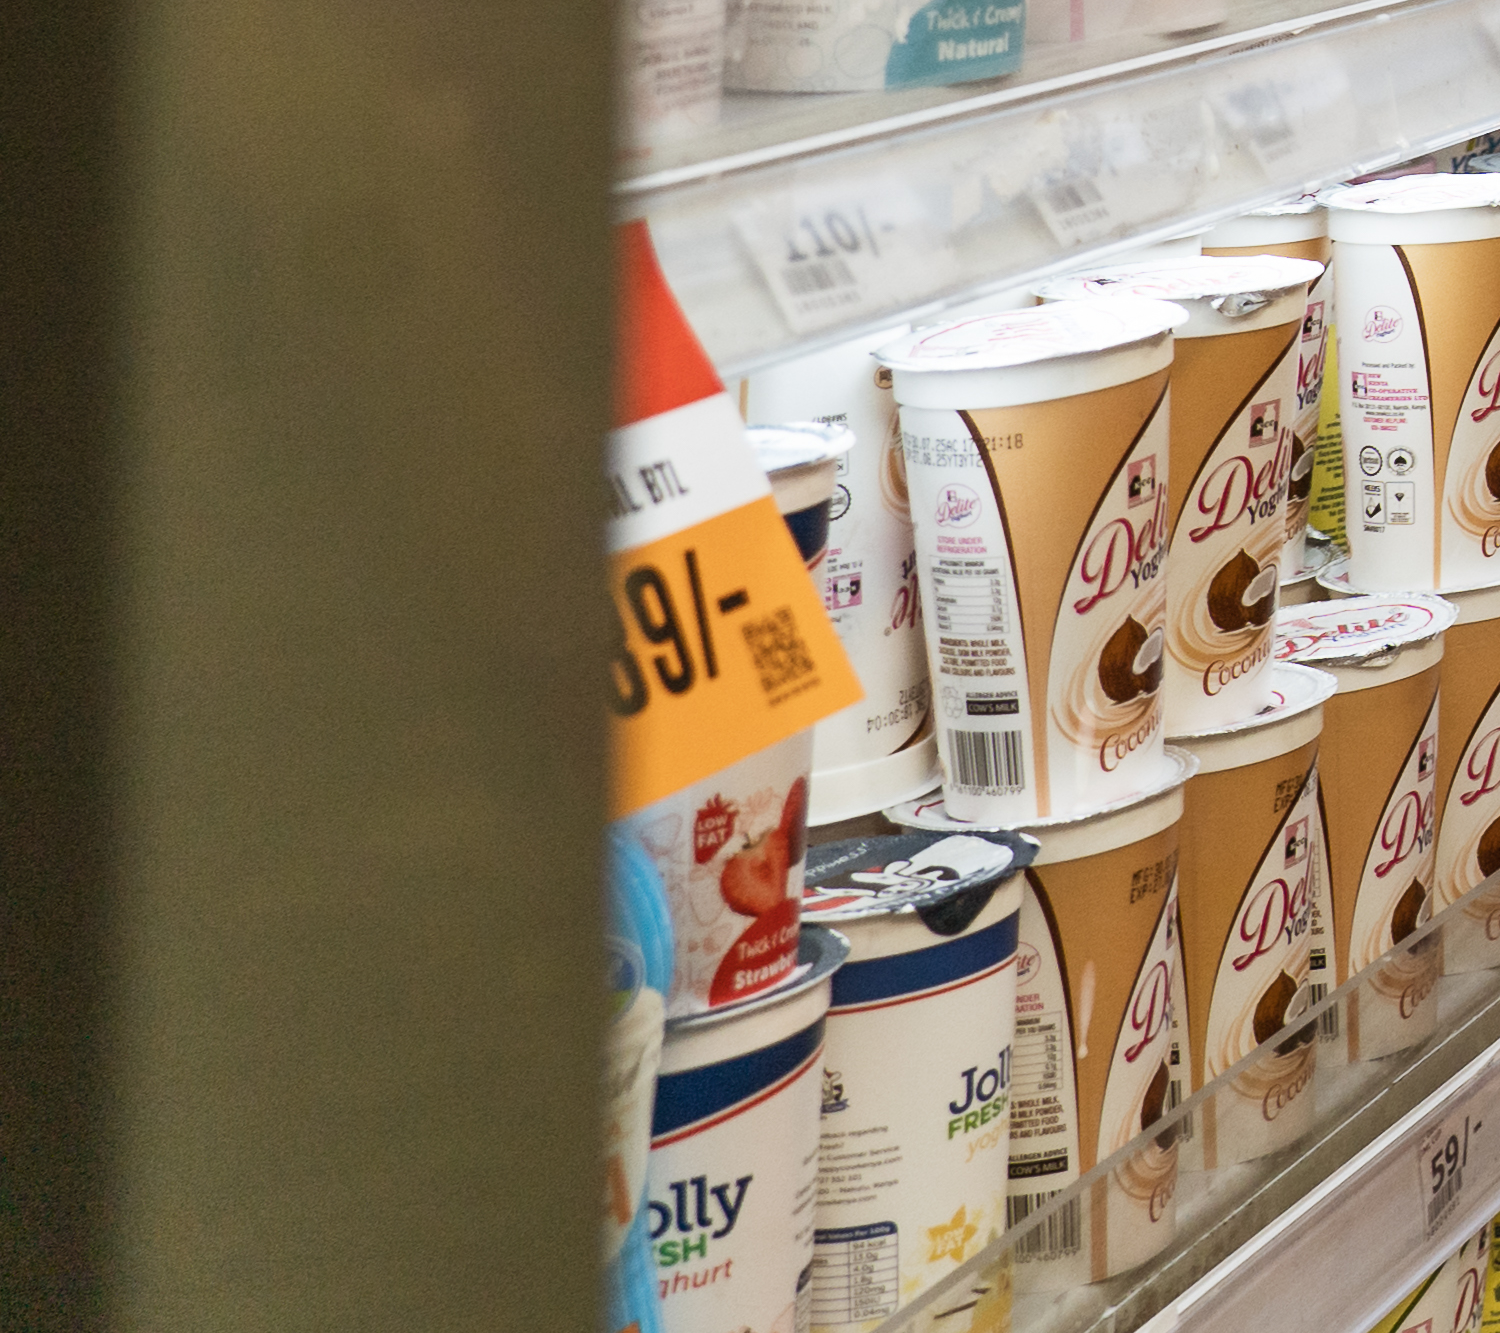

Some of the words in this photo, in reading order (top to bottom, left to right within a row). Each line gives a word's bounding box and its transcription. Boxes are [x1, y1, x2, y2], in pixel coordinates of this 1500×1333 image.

[937, 33, 1010, 64] Natural
[646, 458, 688, 504] BTL
[1430, 1114, 1483, 1195] 59/-
